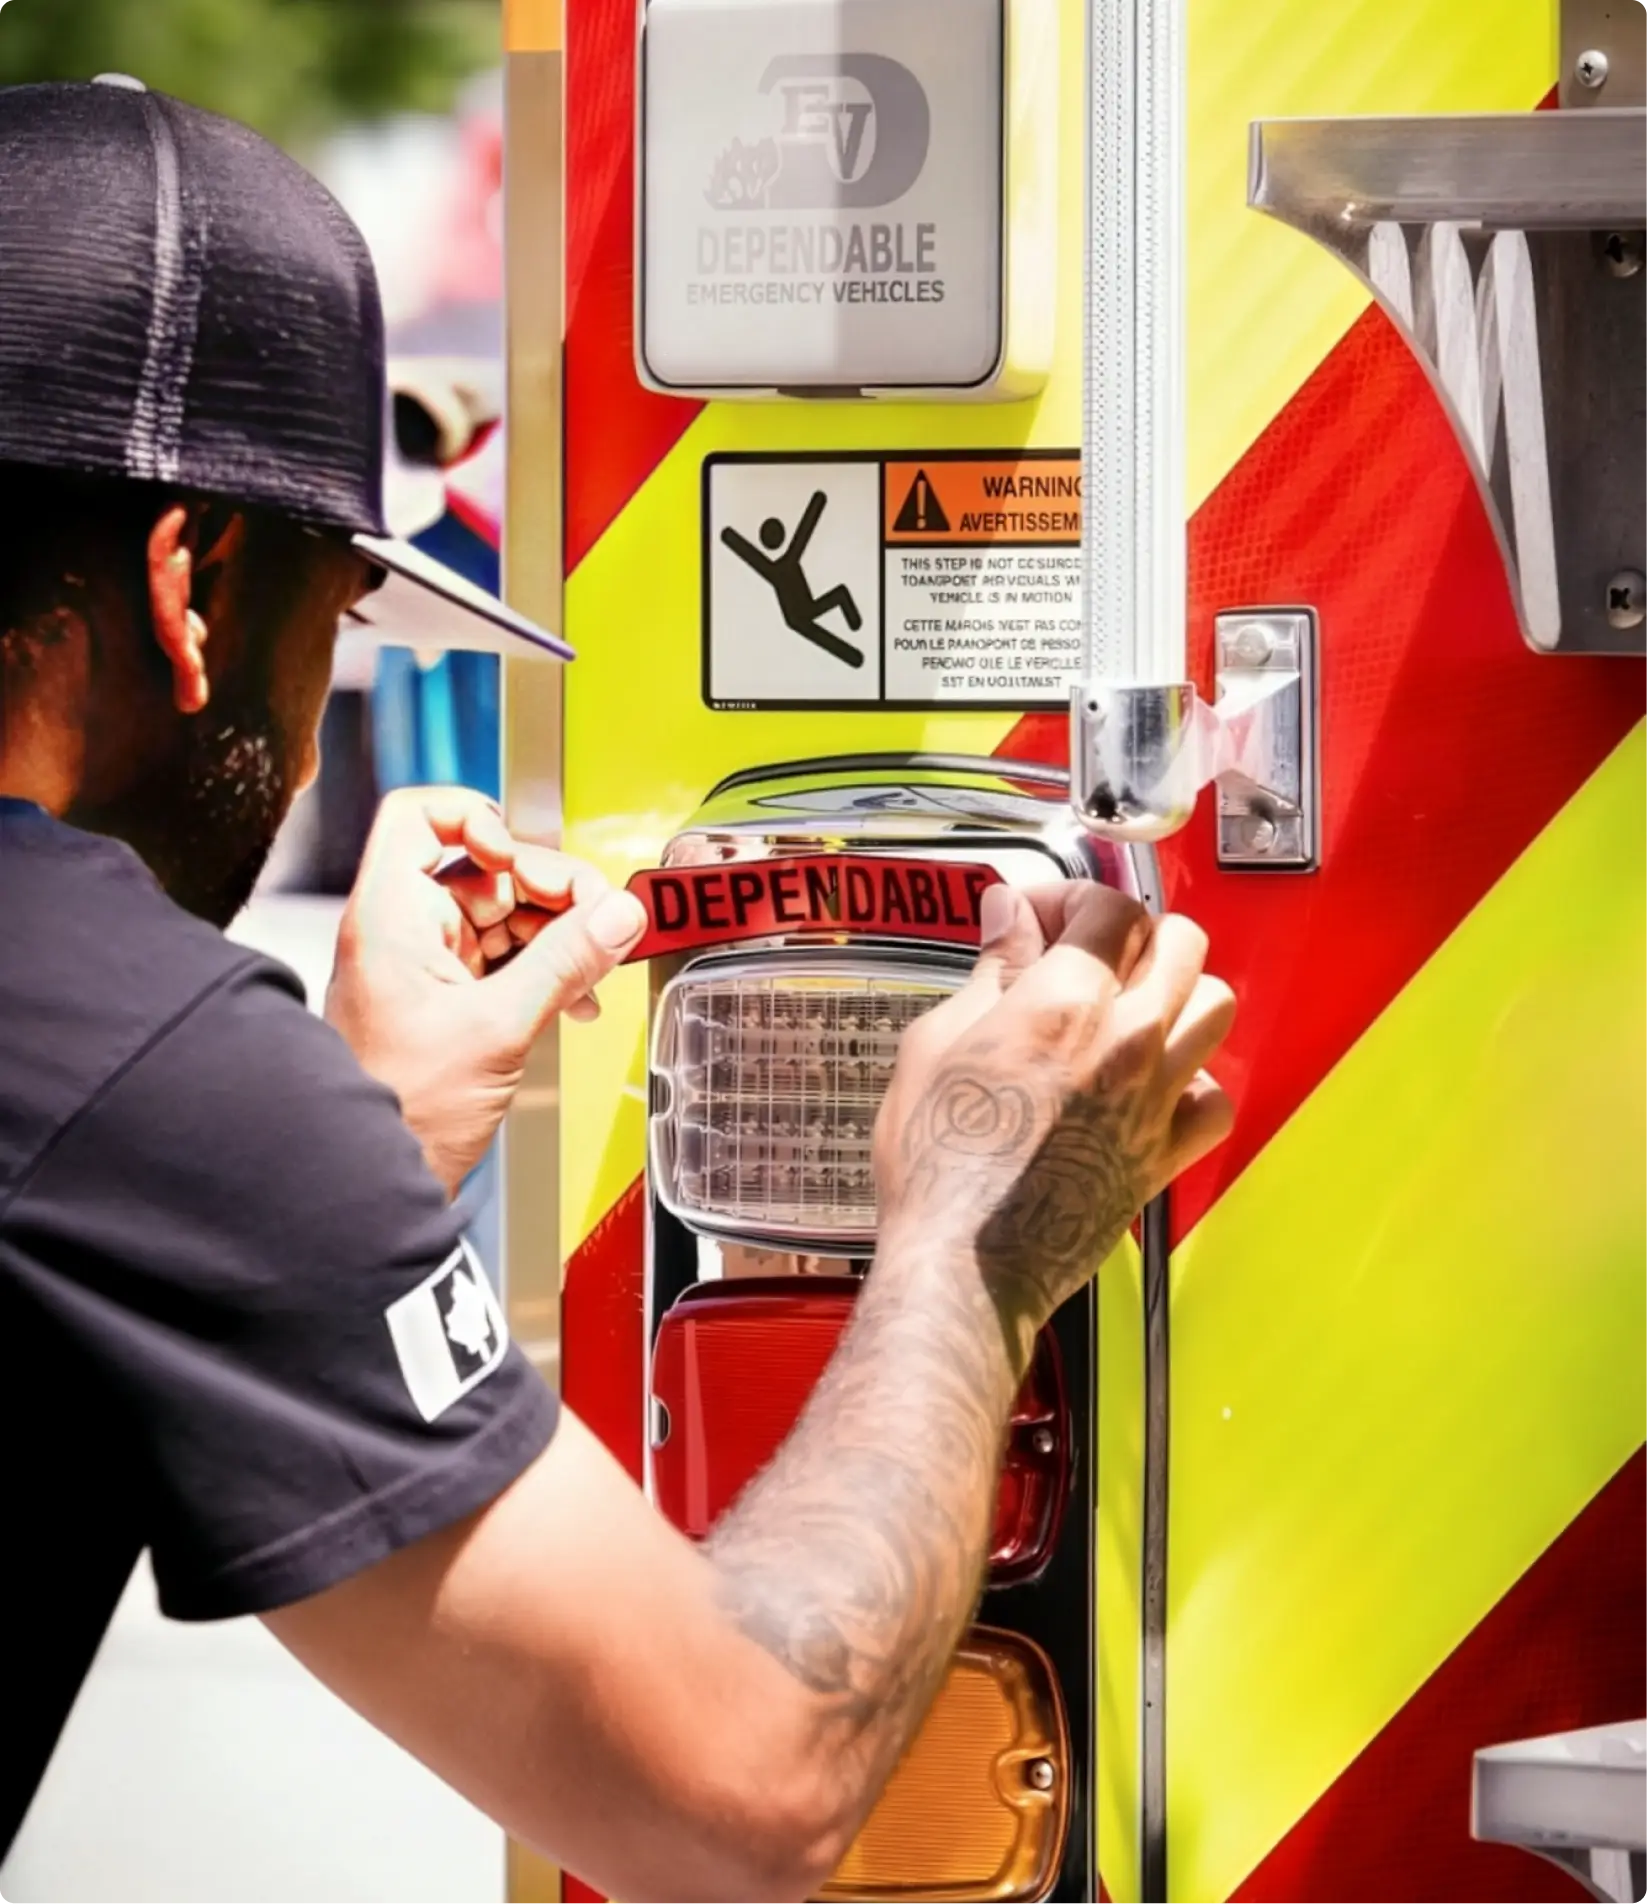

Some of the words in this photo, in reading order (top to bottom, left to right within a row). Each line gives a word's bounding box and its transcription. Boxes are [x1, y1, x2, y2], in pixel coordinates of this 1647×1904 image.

[696, 222, 937, 275] DEPENDABLE
[686, 281, 825, 305] EMERGENCY
[832, 280, 945, 303] VEHICLES
[901, 558, 931, 570] THIS
[935, 558, 967, 570] STEP
[988, 558, 1014, 570] NOT
[1022, 592, 1072, 603] MOTION
[903, 619, 942, 631] CETTE
